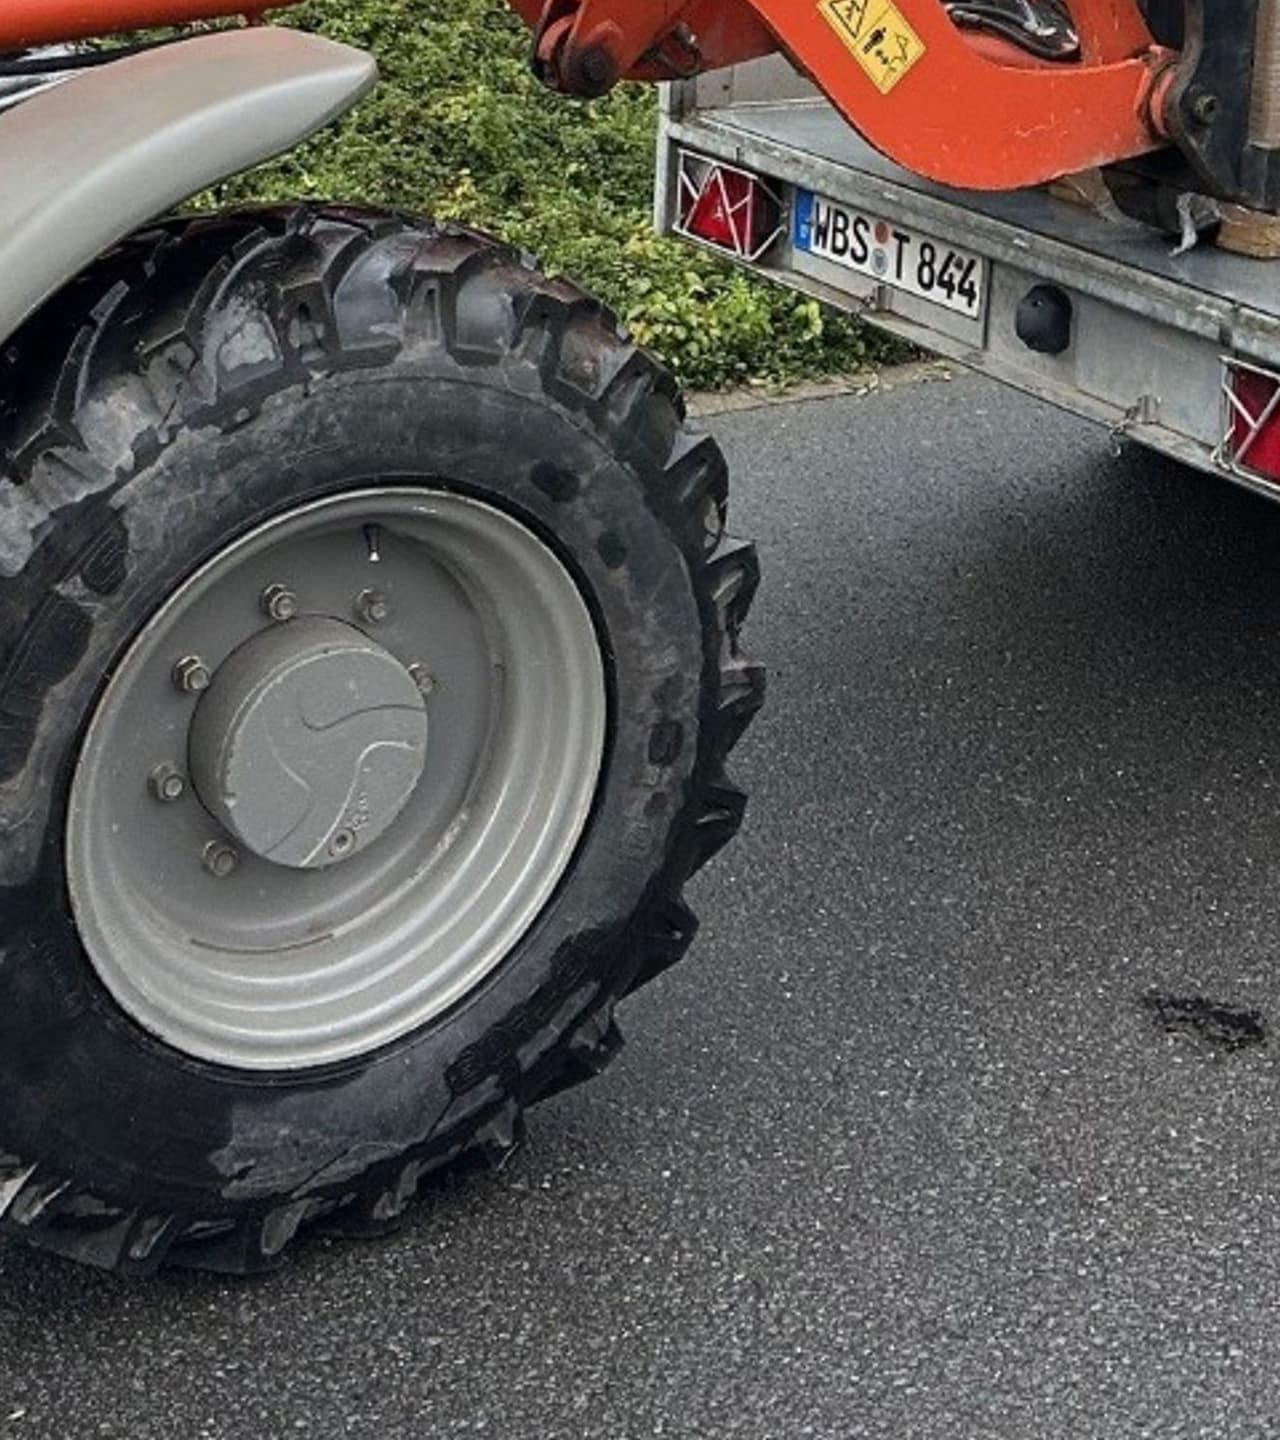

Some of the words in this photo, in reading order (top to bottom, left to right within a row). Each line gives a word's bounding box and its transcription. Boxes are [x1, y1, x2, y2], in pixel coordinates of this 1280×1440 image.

[814, 202, 870, 264] WBS
[892, 231, 910, 280] T
[917, 242, 977, 308] 844
